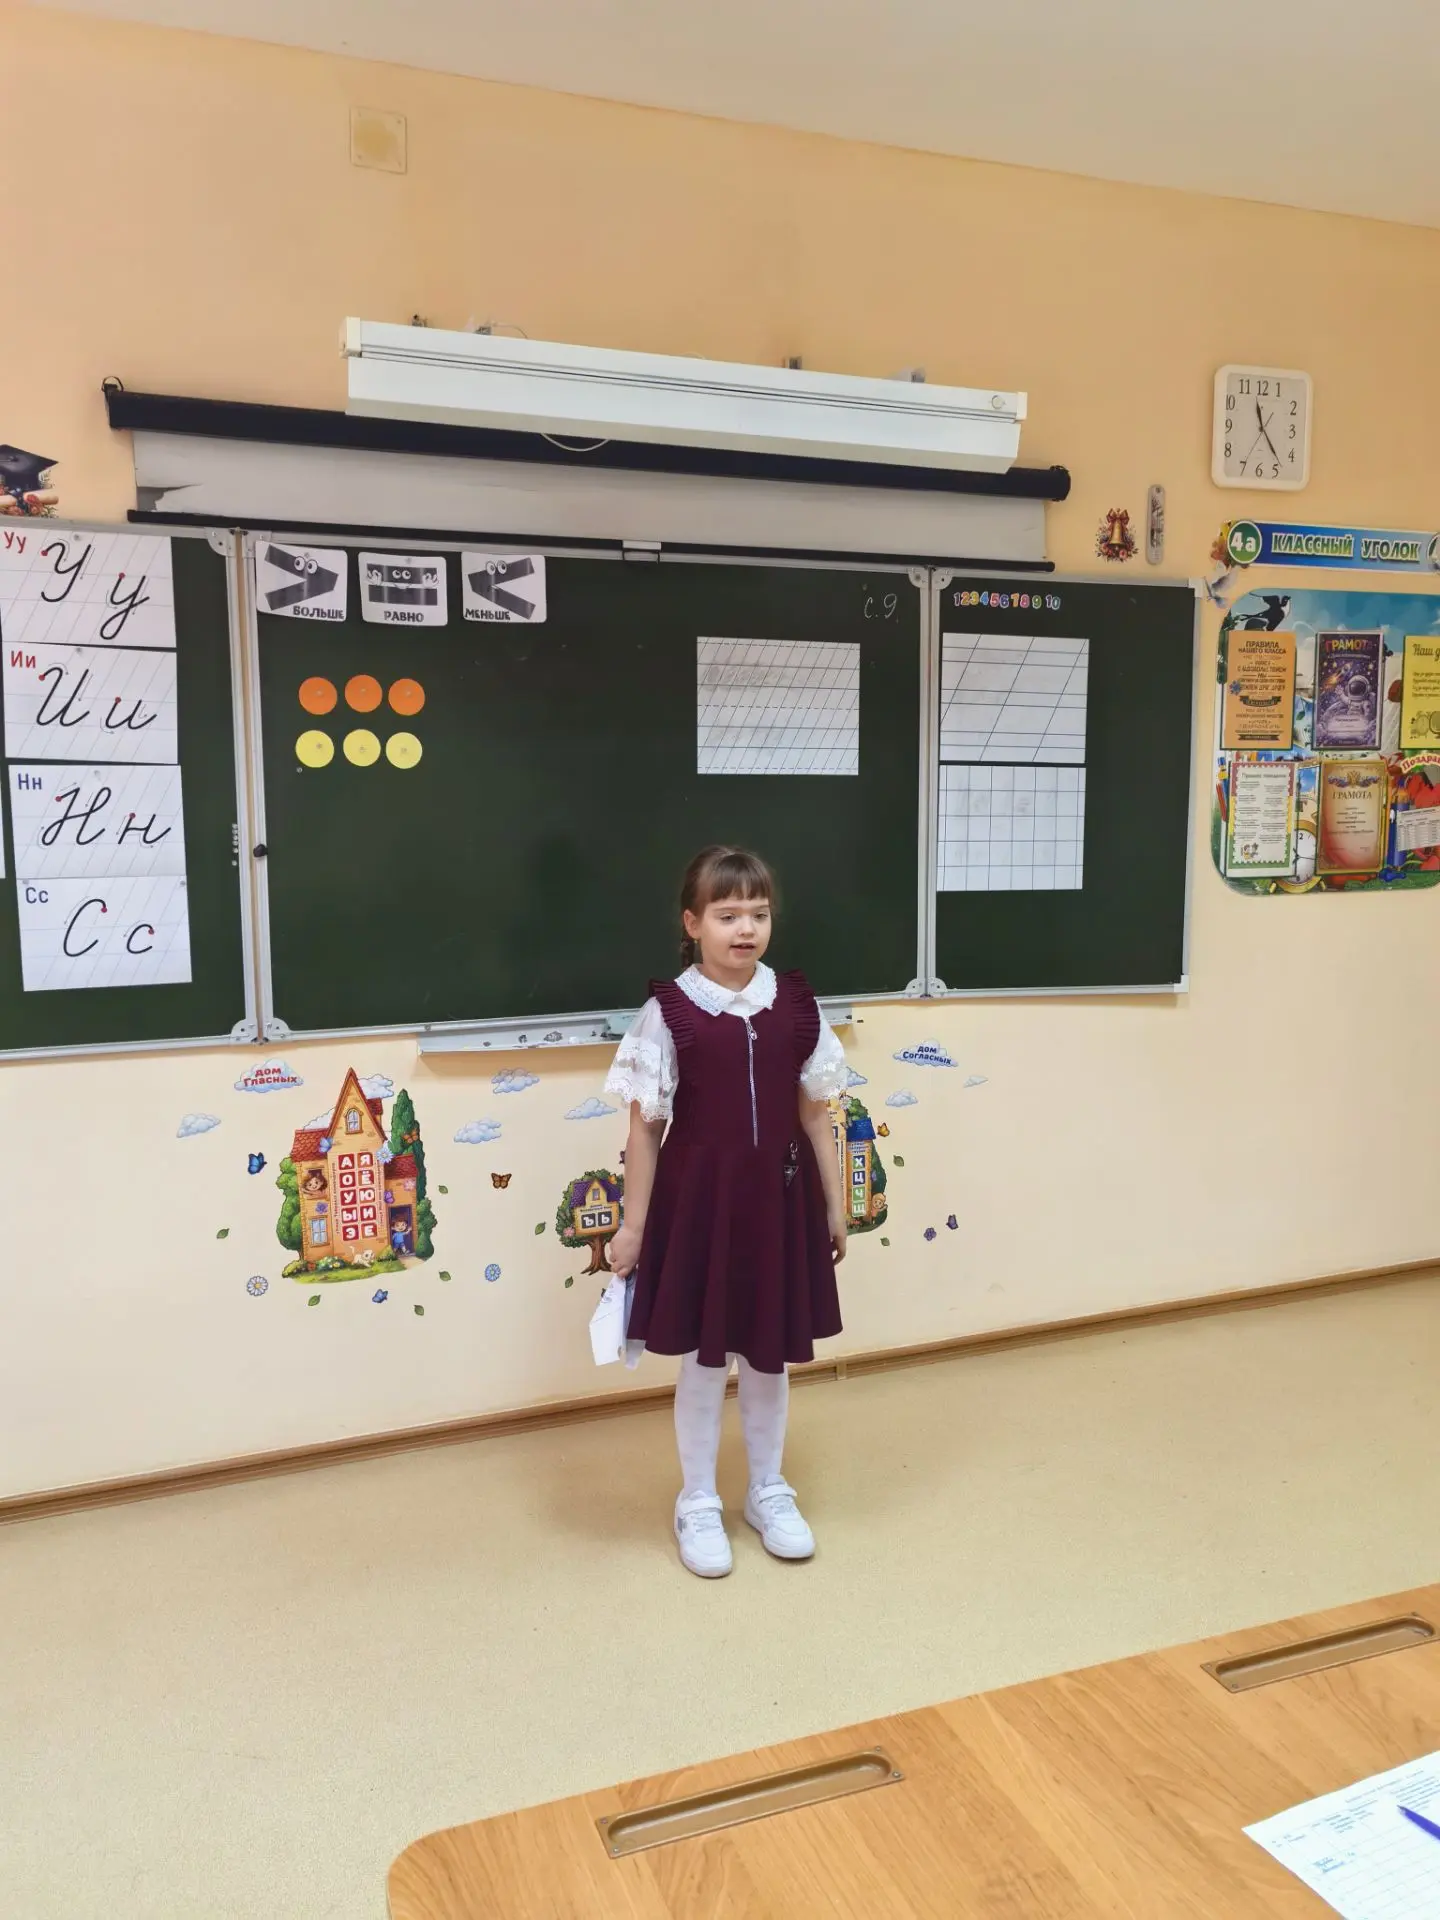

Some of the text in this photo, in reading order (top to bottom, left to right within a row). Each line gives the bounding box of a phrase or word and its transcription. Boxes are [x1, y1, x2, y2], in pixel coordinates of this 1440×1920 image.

[1239, 379, 1281, 397] 11 12 1
[1225, 394, 1236, 411] 10
[1289, 400, 1298, 416] 2
[1225, 418, 1233, 434] 9
[1288, 424, 1296, 439] 3
[1224, 442, 1232, 458] 8
[1288, 448, 1295, 463] 4
[1239, 460, 1279, 479] 7 6 5
[4, 531, 27, 554] Уу
[1272, 532, 1353, 557] КЛАССНЫЙ
[1361, 538, 1421, 562] УГОЛОК
[41, 542, 150, 640] У у
[292, 605, 345, 620] БОЛЬШЕ
[384, 610, 425, 622] РАВНО
[464, 607, 511, 621] МЕНЬШЕ
[11, 650, 36, 669] Ии
[36, 667, 90, 726] И
[18, 773, 42, 790] Нн
[1332, 791, 1372, 800] ГРАМОТА
[41, 786, 171, 846] Н н
[25, 887, 49, 904] Сс
[63, 898, 107, 957] С
[341, 1154, 371, 1168] А Я
[361, 1170, 372, 1185] Ё
[343, 1190, 375, 1204] У Ю
[342, 1207, 374, 1221] Ы И
[345, 1225, 375, 1239] Э Е
